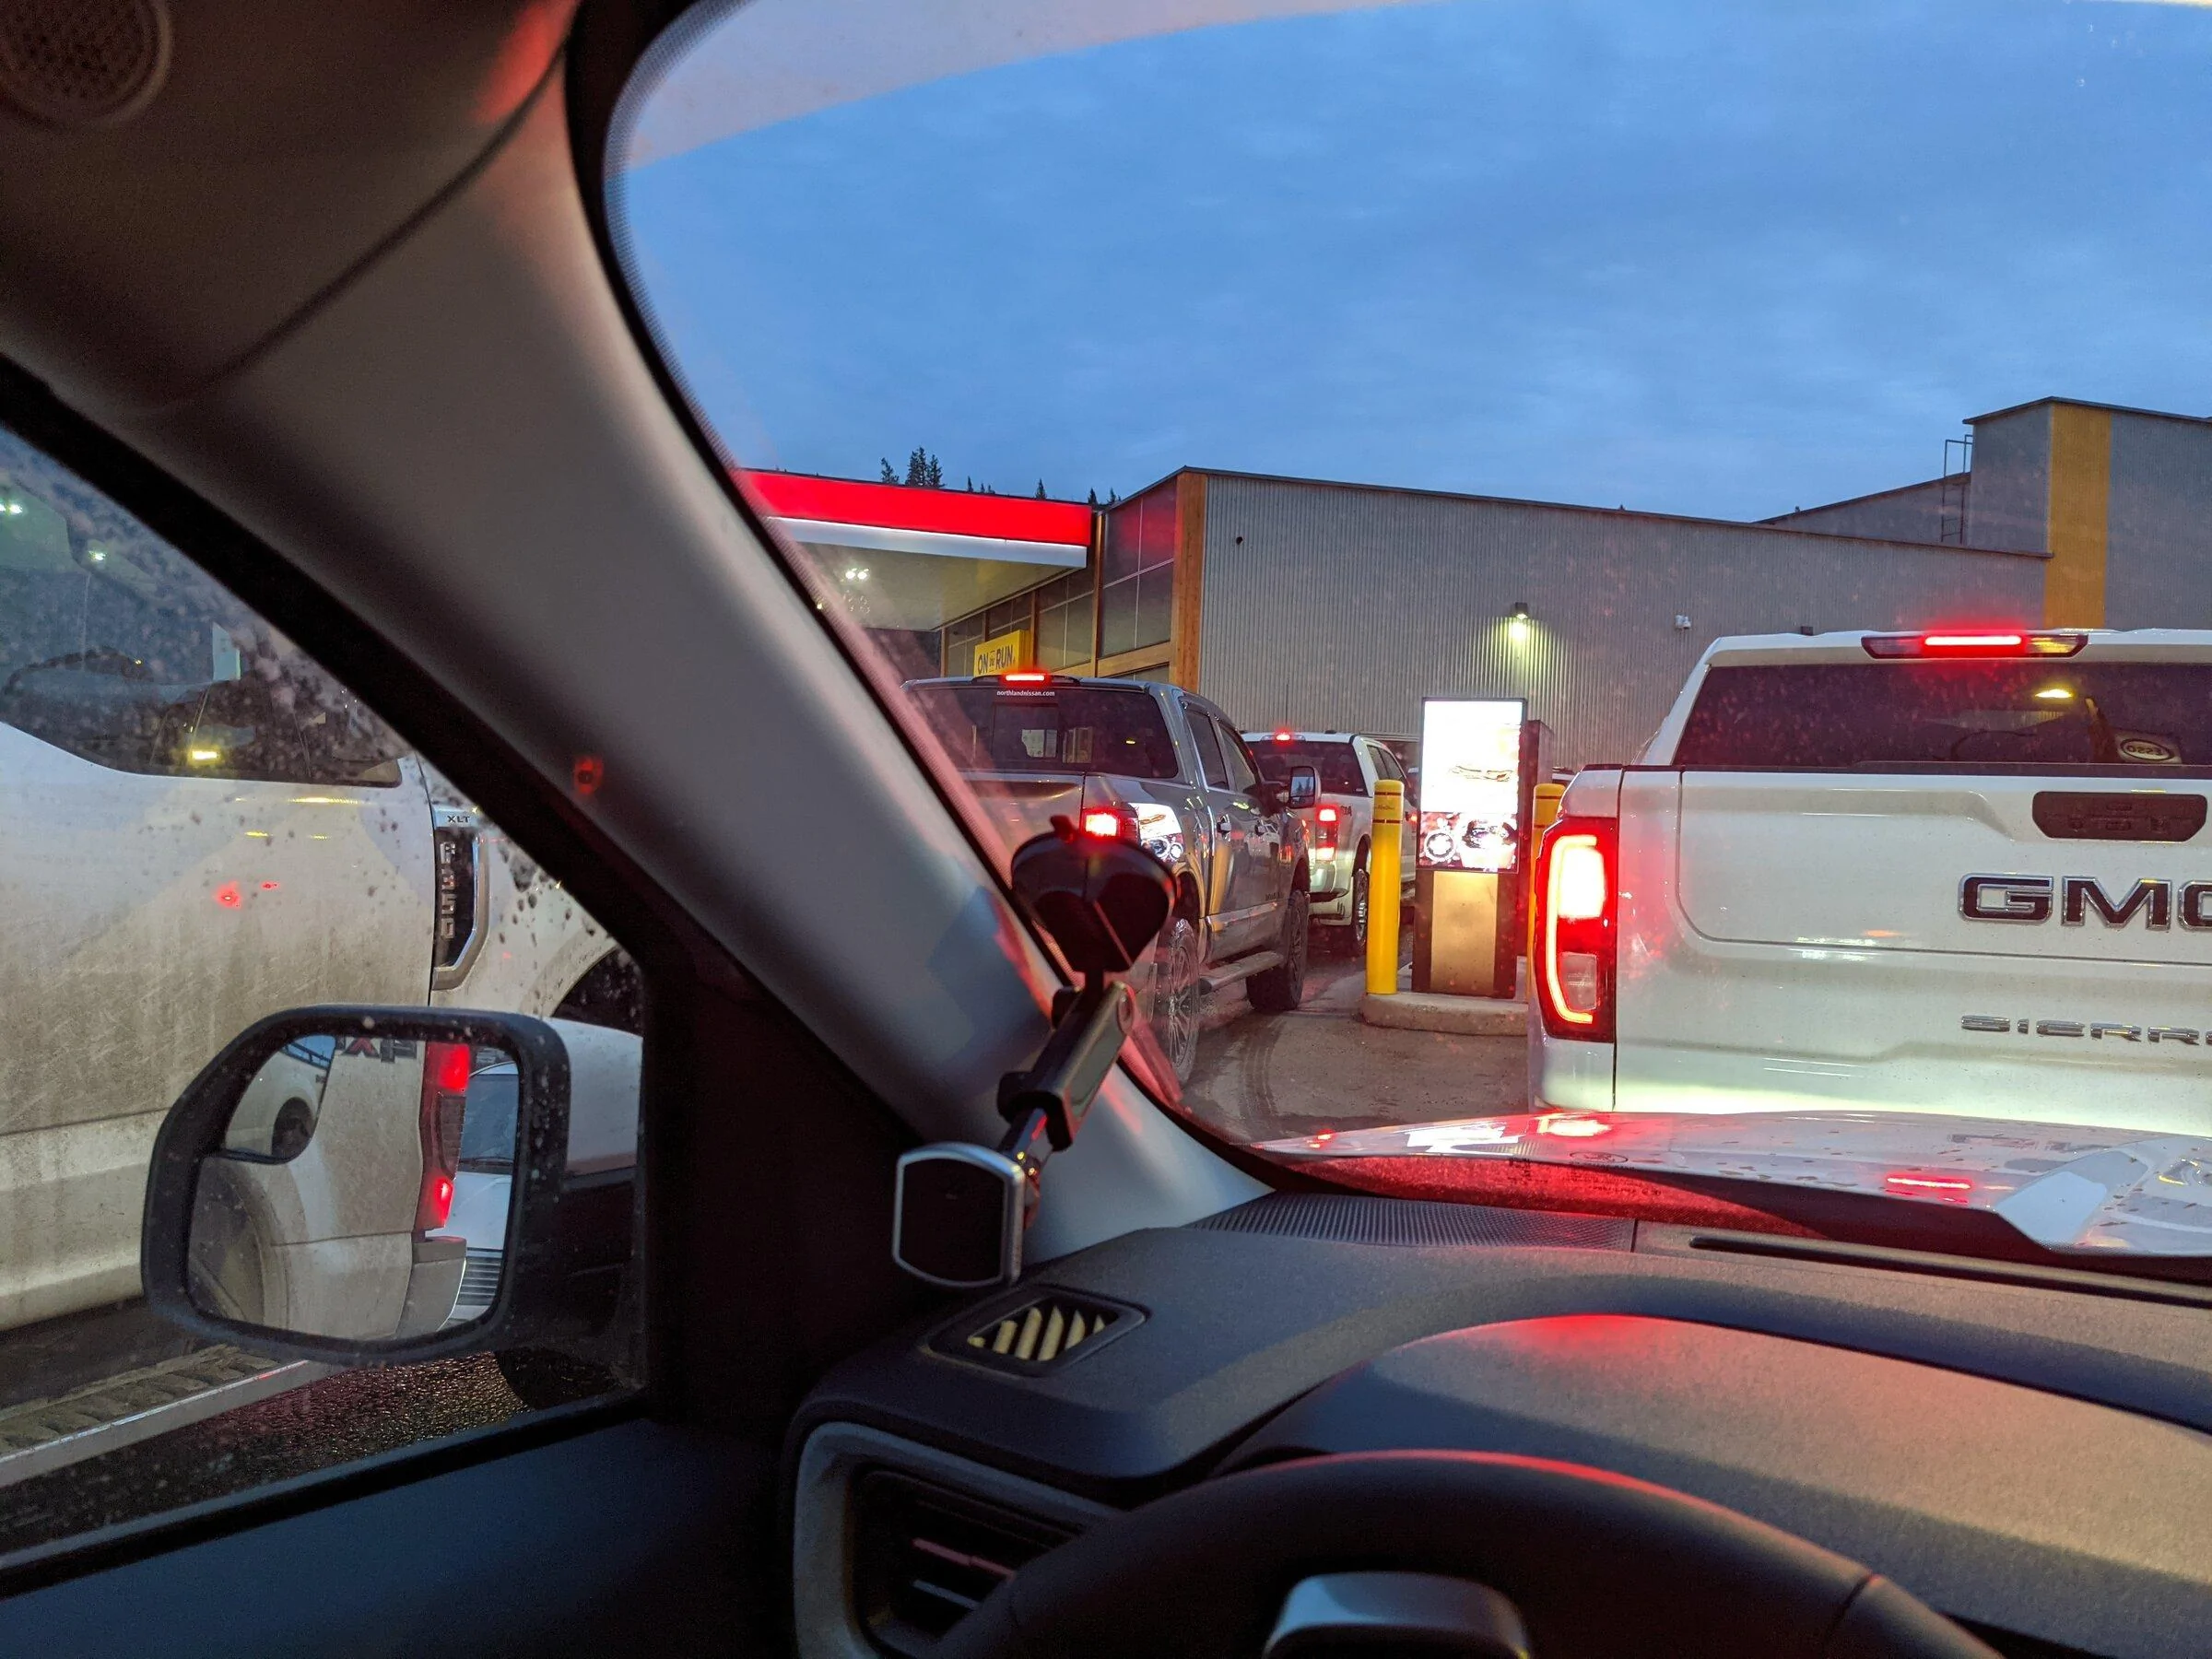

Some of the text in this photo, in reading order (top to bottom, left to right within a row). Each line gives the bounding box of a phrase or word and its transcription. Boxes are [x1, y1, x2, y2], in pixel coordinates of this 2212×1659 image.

[978, 652, 989, 675] ON
[995, 644, 1013, 670] RUN
[447, 815, 470, 823] XLT
[1961, 1015, 2212, 1046] SIERR
